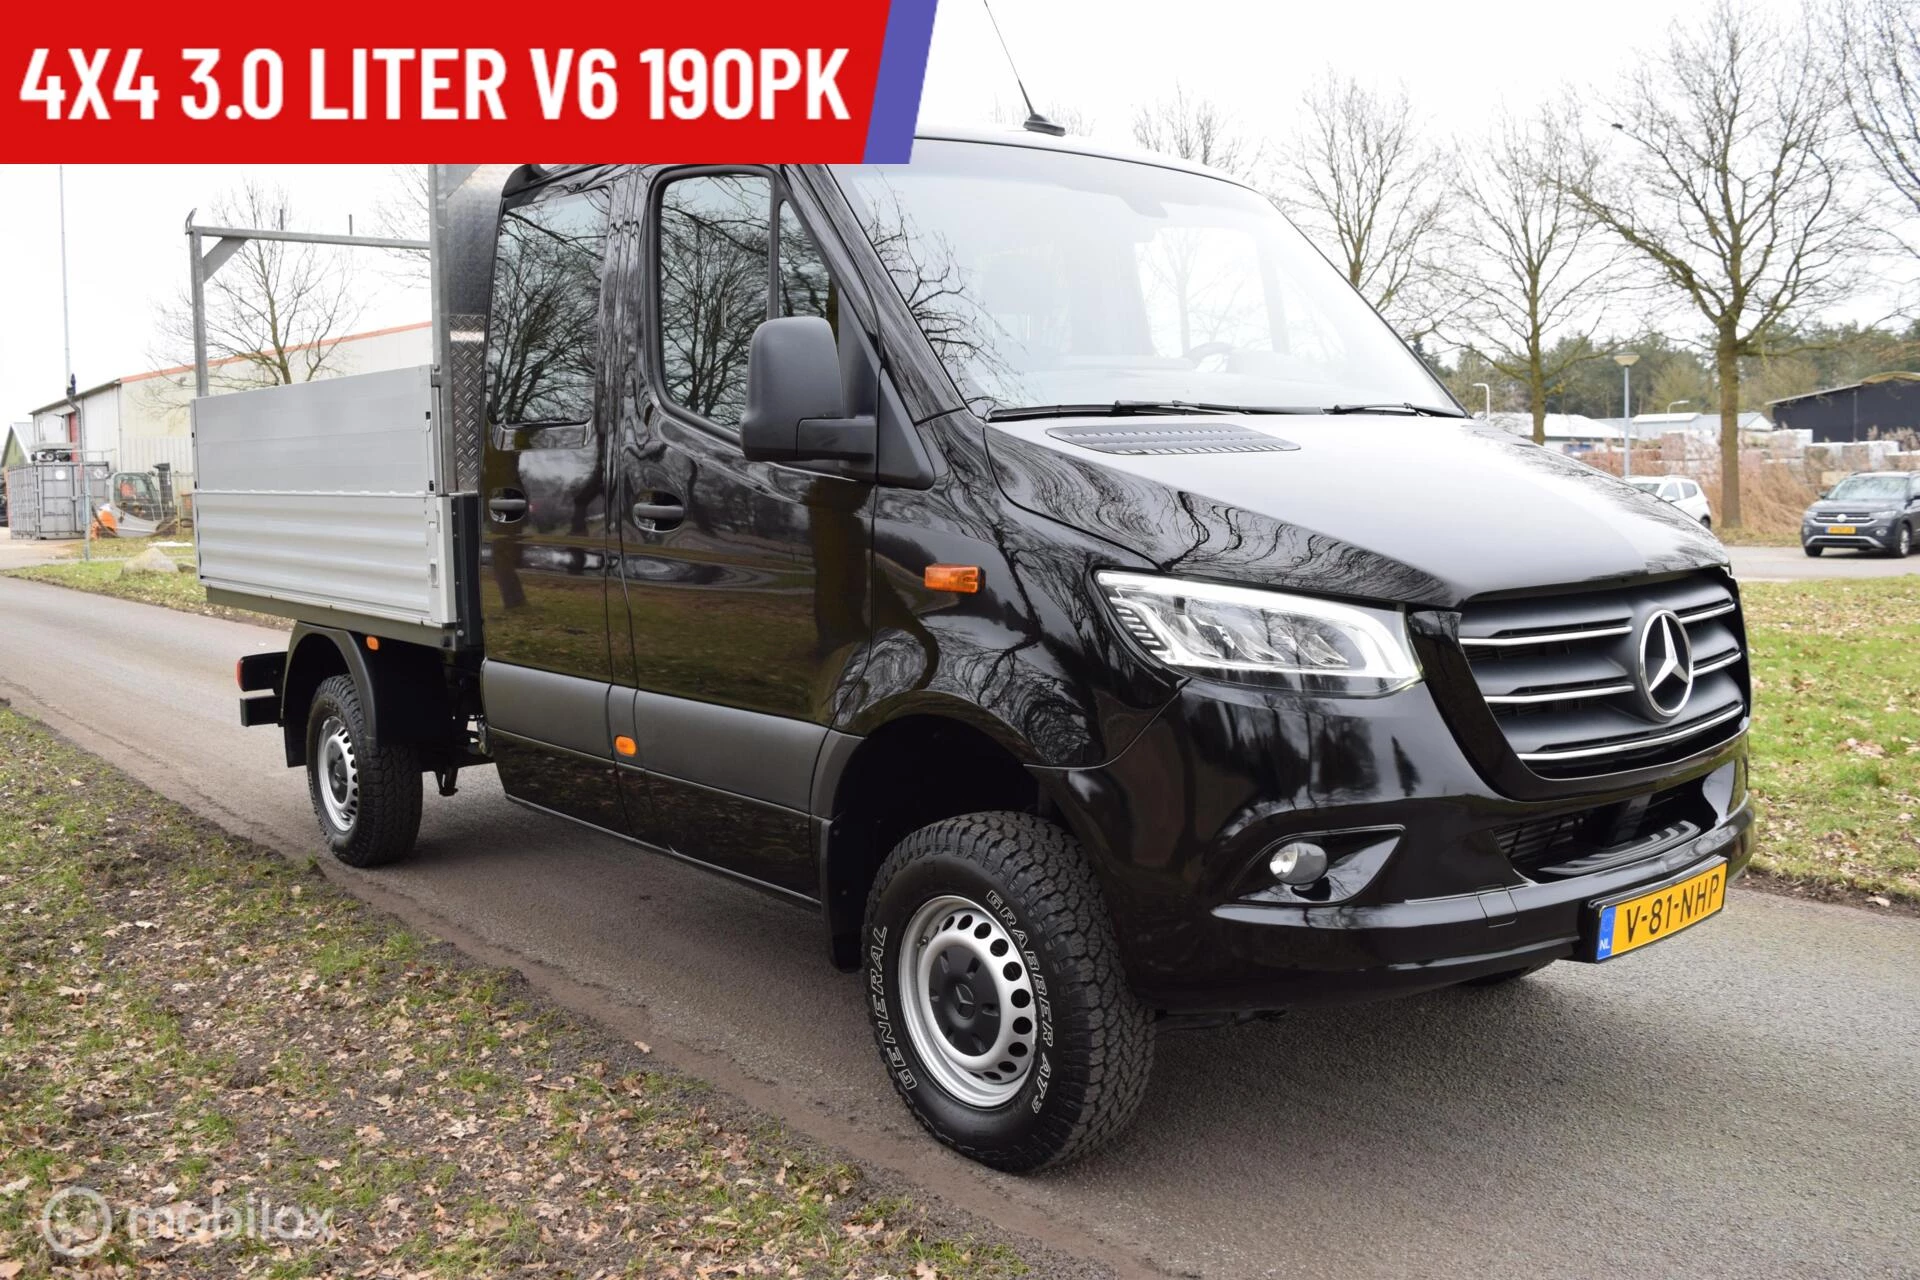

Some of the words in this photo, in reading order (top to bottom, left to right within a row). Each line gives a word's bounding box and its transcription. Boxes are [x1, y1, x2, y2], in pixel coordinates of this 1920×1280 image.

[1599, 938, 1611, 951] NL
[1626, 873, 1720, 943] V-81-NHP
[870, 925, 918, 1090] GENERAL
[986, 889, 1055, 1047] GRABBER
